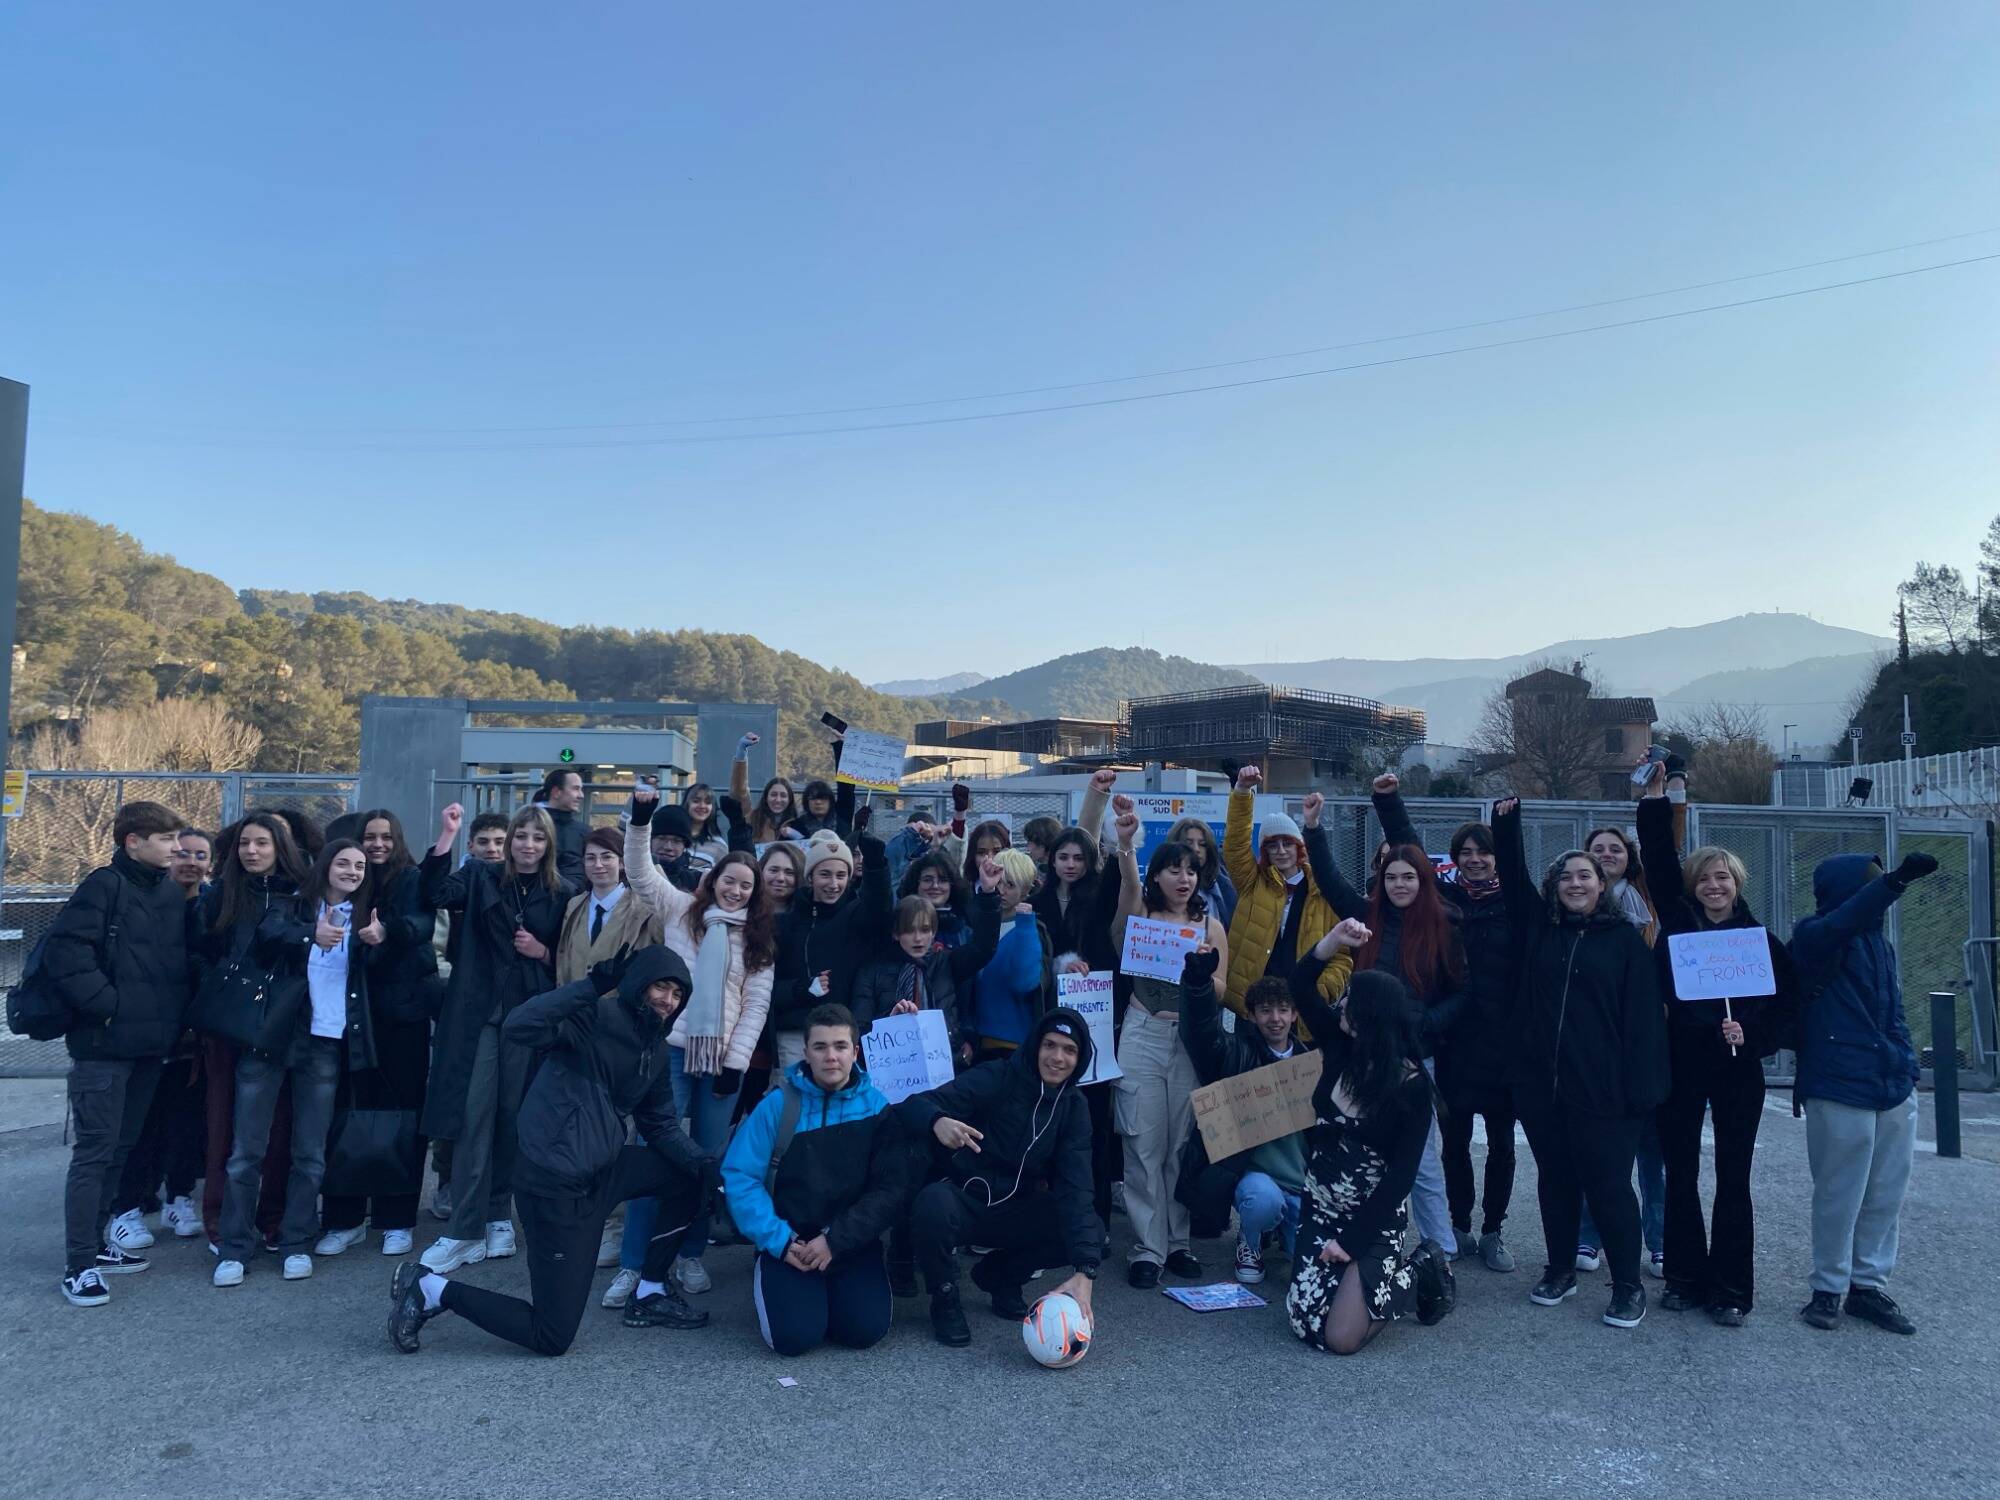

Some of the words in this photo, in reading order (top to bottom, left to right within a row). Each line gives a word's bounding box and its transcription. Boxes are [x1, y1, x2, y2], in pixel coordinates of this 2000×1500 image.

[1903, 735, 1915, 743] 2V
[1152, 806, 1171, 814] SUD
[1697, 963, 1767, 985] FRONTS
